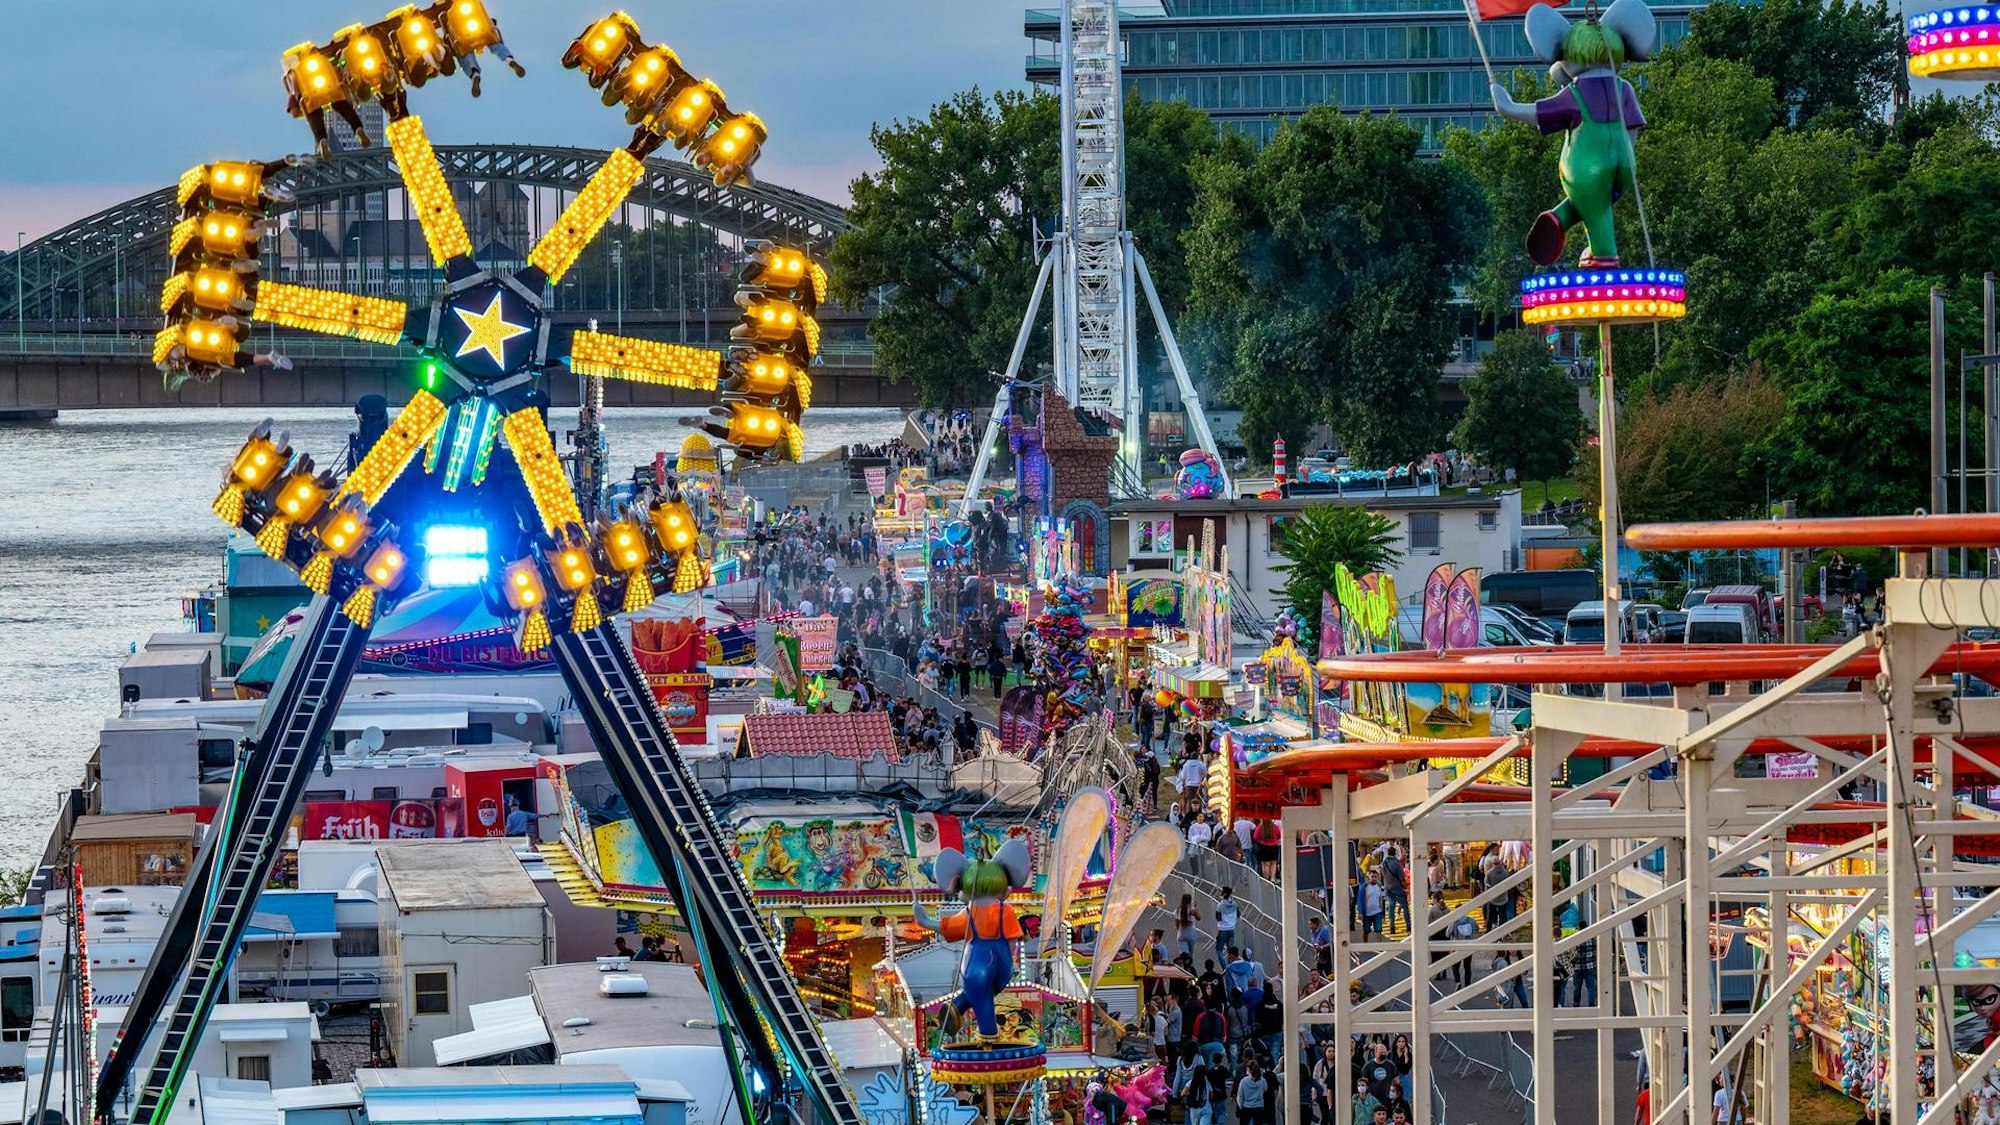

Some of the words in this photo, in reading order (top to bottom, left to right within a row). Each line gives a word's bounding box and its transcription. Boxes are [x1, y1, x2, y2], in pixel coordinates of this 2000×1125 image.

[805, 624, 827, 632] Das
[428, 645, 453, 663] DU
[801, 641, 833, 653] Bogen-
[320, 815, 379, 841] Früh
